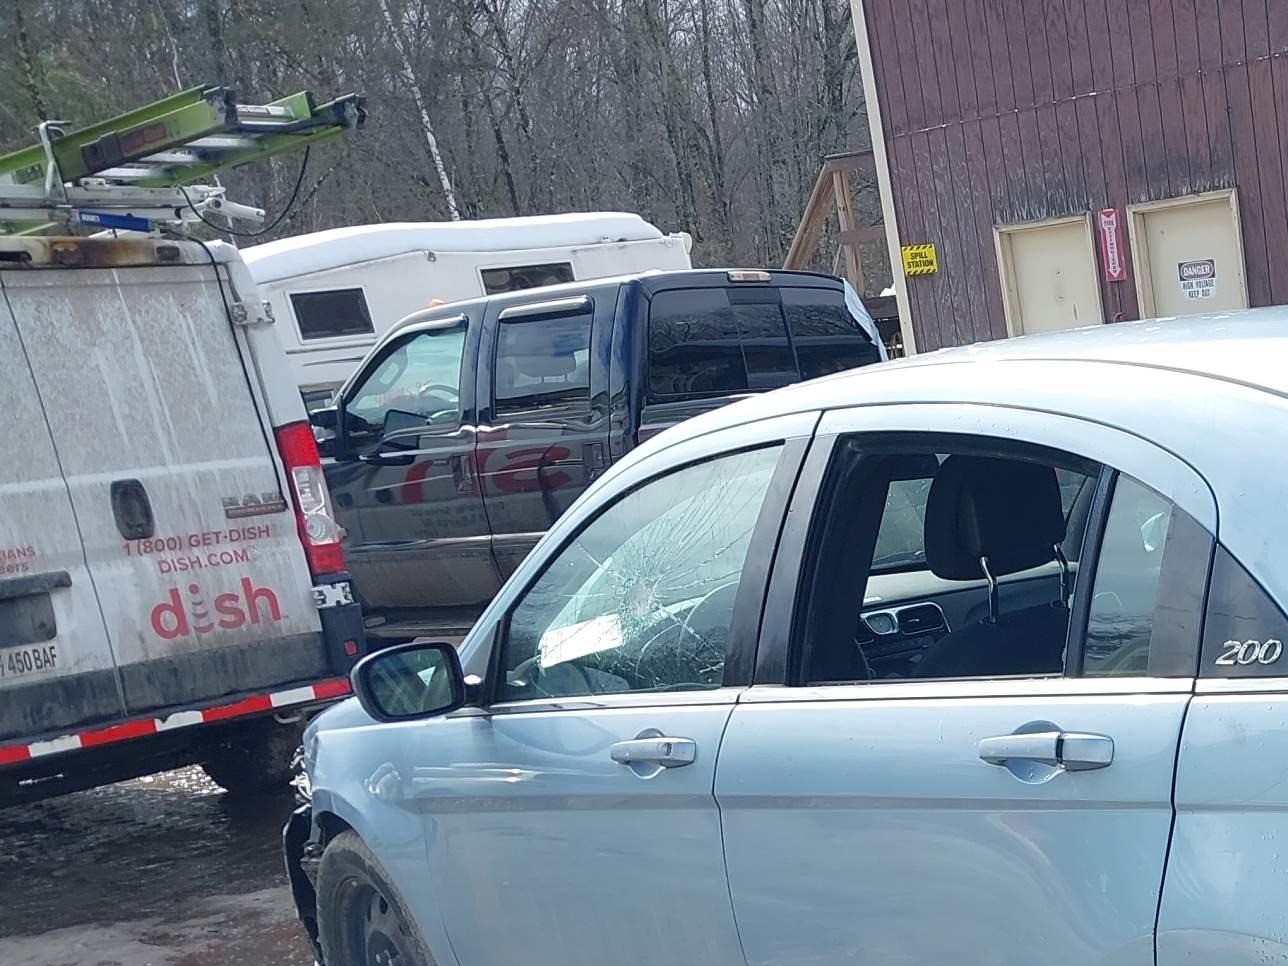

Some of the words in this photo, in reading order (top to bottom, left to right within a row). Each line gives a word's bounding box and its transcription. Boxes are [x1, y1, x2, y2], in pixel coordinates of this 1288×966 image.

[907, 259, 934, 269] STATION
[910, 252, 928, 260] SPILL
[1183, 264, 1211, 277] DANGER
[123, 543, 130, 556] 1
[137, 536, 182, 556] (800)
[188, 525, 270, 548] GET-DISH
[0, 546, 36, 561] IANS
[158, 550, 250, 574] DISH.COM
[151, 577, 281, 640] dish
[1215, 639, 1283, 665] 200
